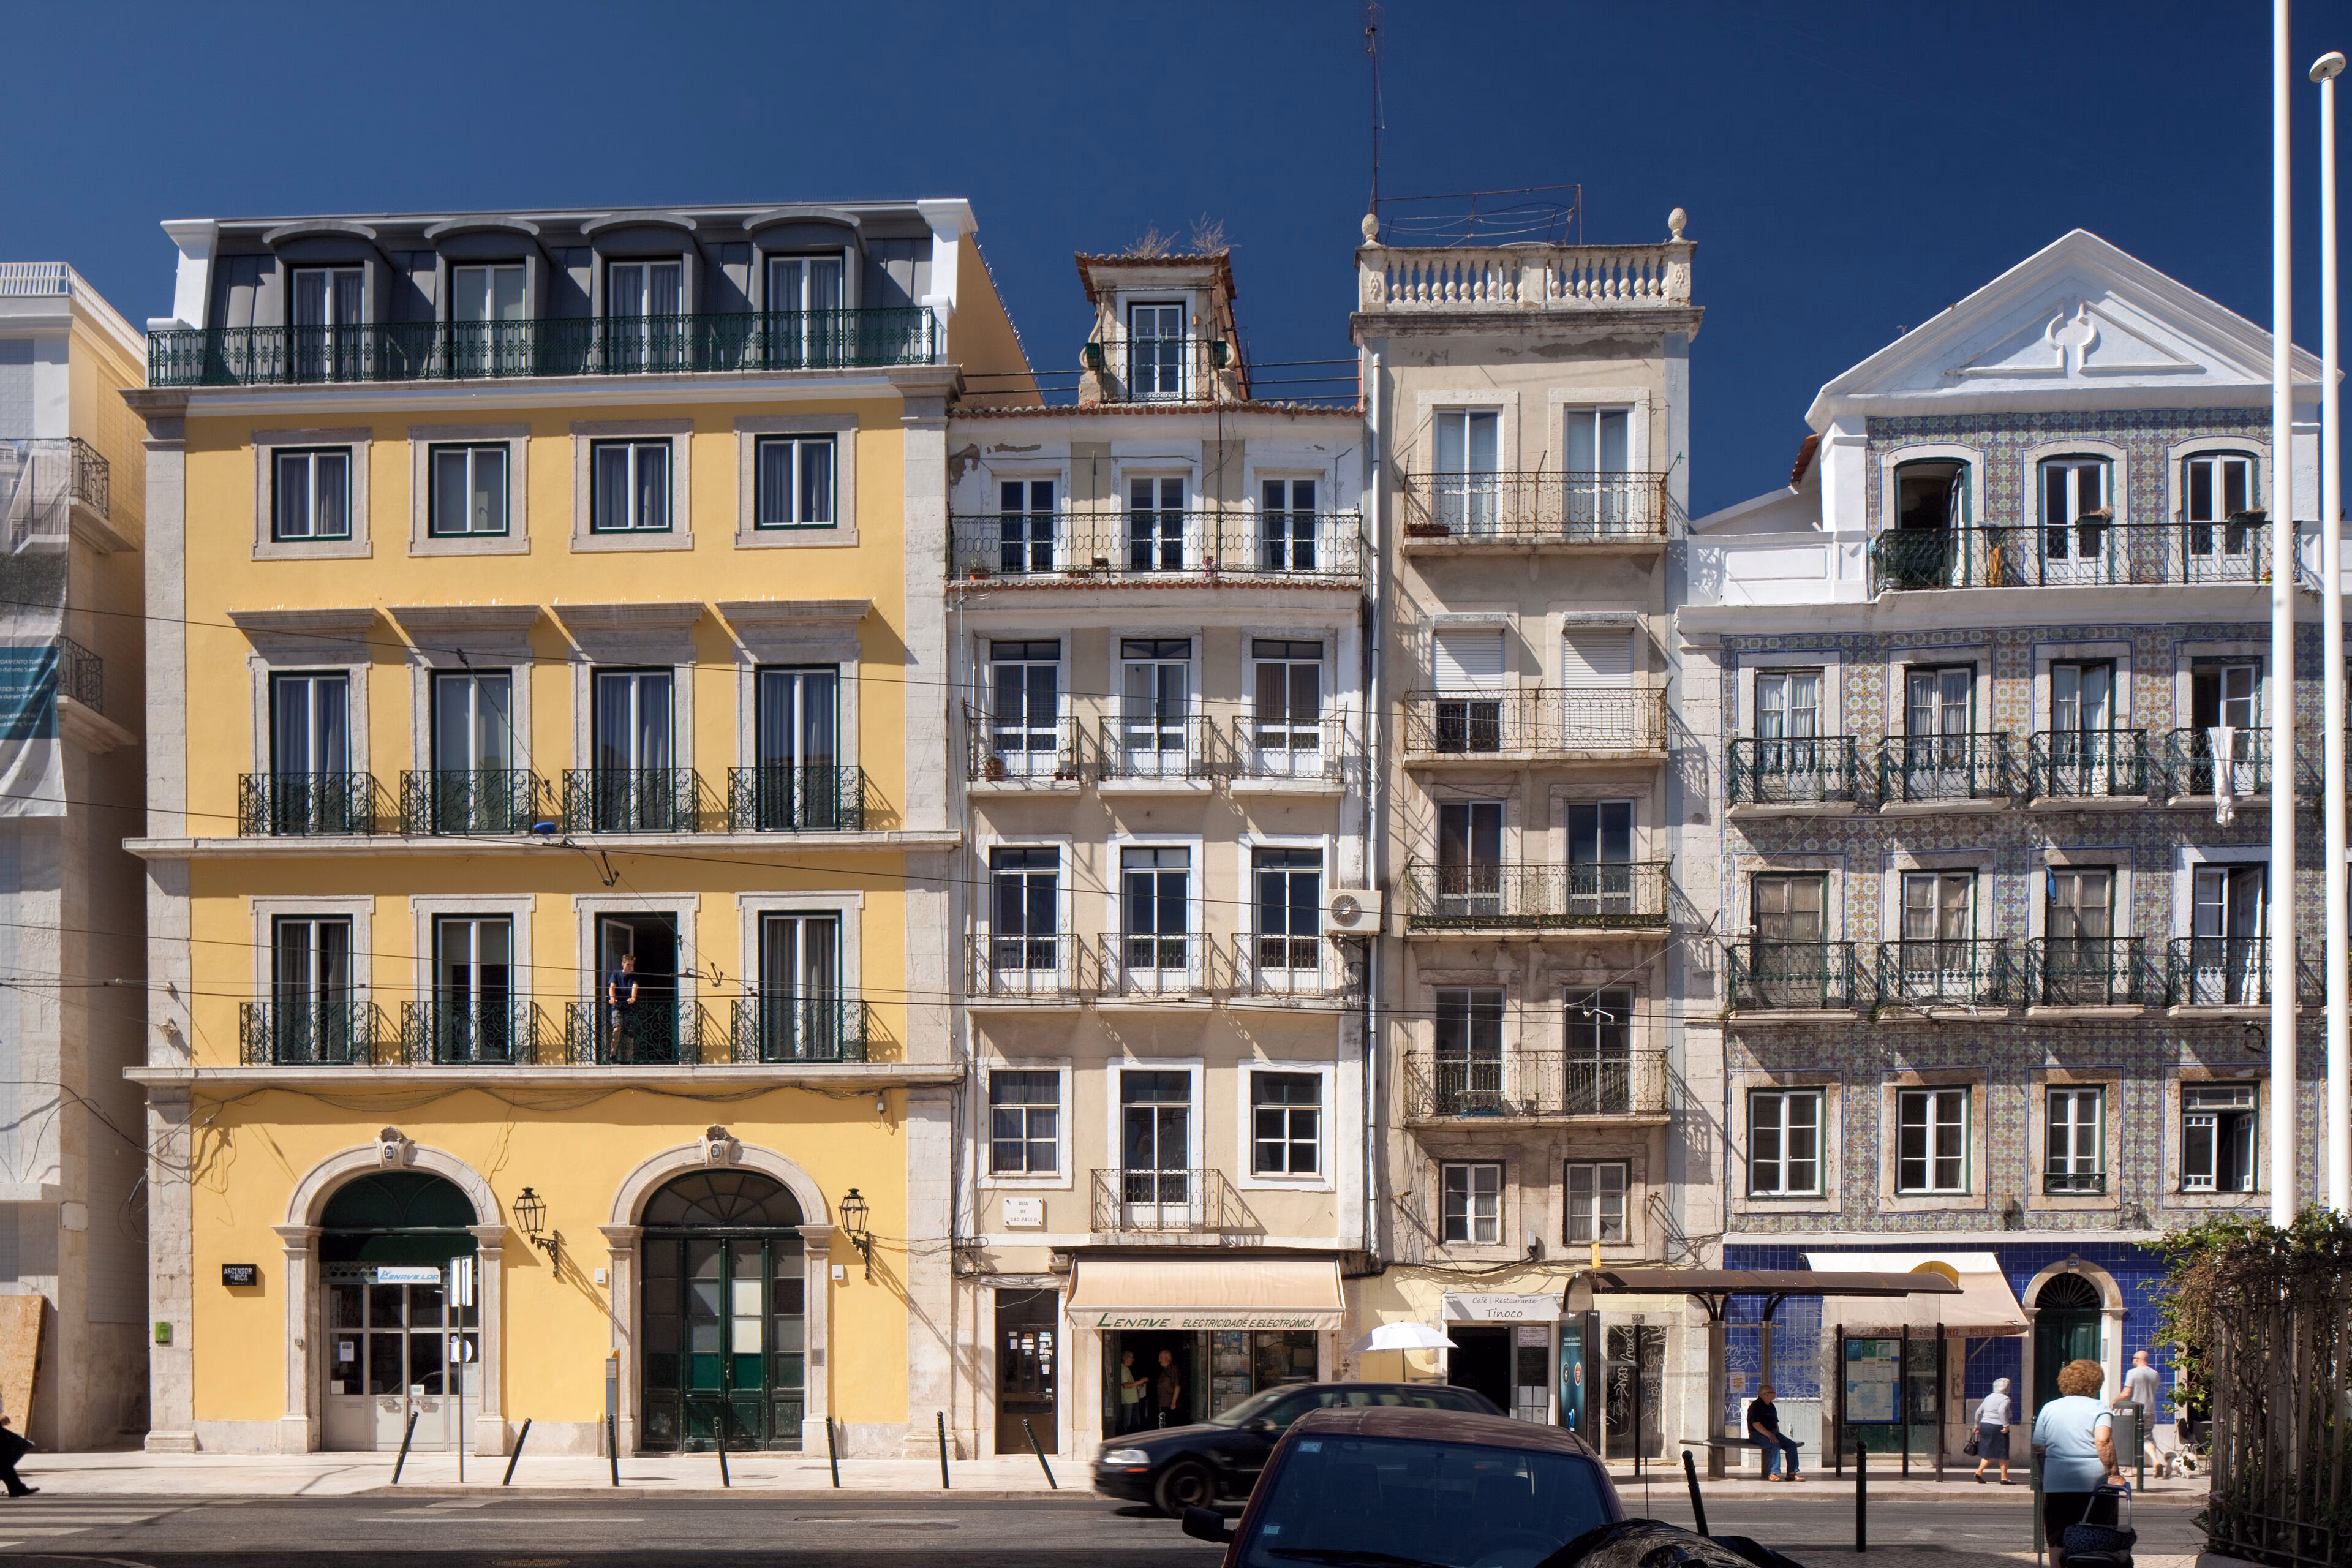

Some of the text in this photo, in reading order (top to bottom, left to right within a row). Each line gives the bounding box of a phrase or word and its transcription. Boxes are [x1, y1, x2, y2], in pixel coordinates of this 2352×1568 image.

[1485, 1308, 1523, 1318] Tinoco
[1182, 1319, 1250, 1328] ELECTRICIDADE
[1249, 1319, 1256, 1328] E
[1256, 1317, 1316, 1328] ELECTRÓNICA
